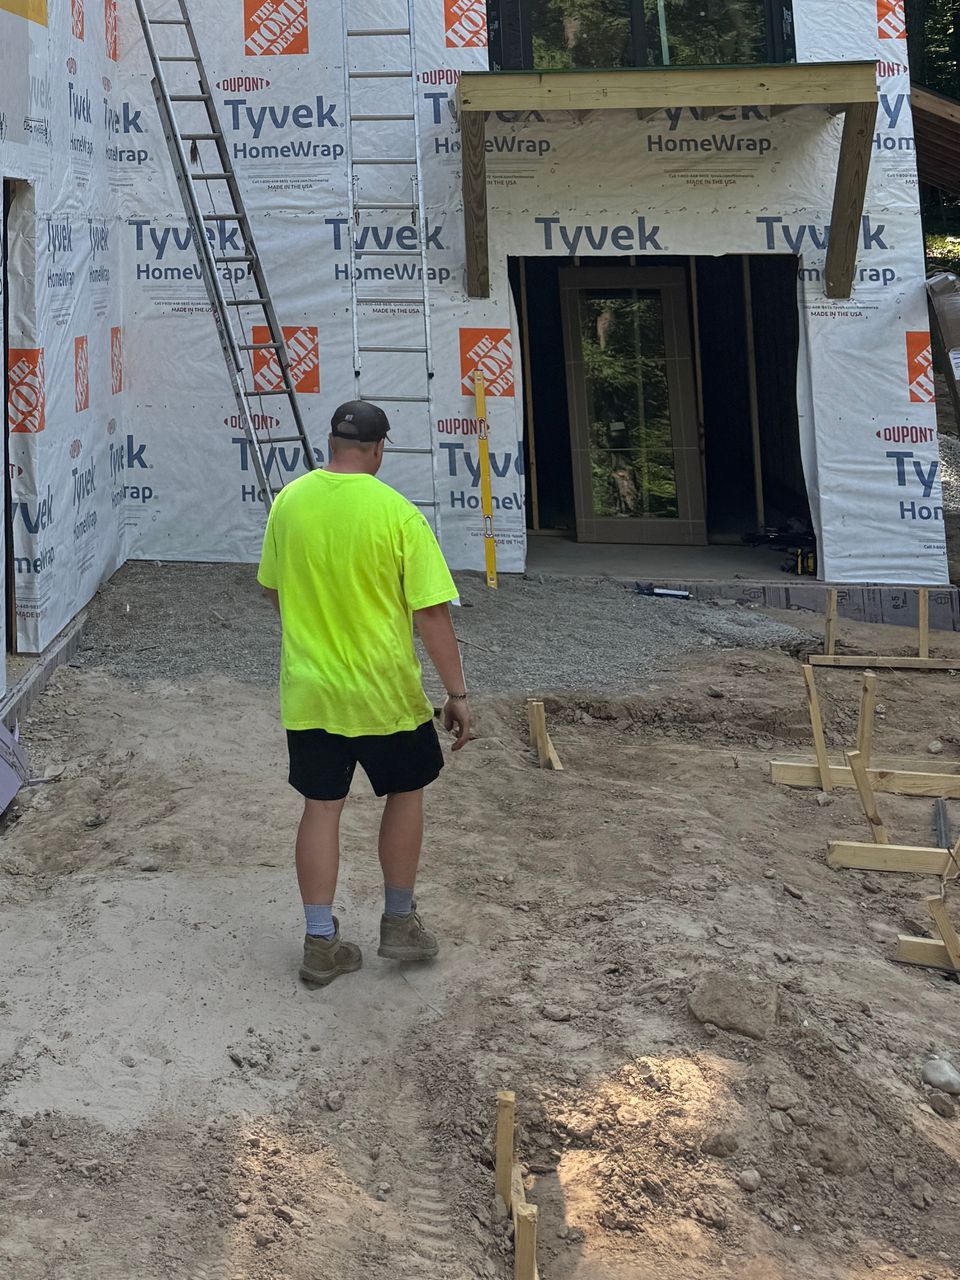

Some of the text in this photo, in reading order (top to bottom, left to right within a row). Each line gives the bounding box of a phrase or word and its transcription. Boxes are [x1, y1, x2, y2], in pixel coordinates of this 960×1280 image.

[250, 0, 276, 25] THE
[270, 14, 308, 56] DEPOT
[223, 76, 265, 93] DUPONT
[223, 95, 339, 139] Tyvek
[233, 140, 344, 160] HomeWrap
[647, 134, 772, 155] HomeWrap
[534, 216, 665, 255] Tyvek
[756, 214, 889, 254] Tyvk
[466, 334, 495, 363] THE
[883, 425, 934, 444] DUPONT
[71, 455, 97, 514] Tyvek
